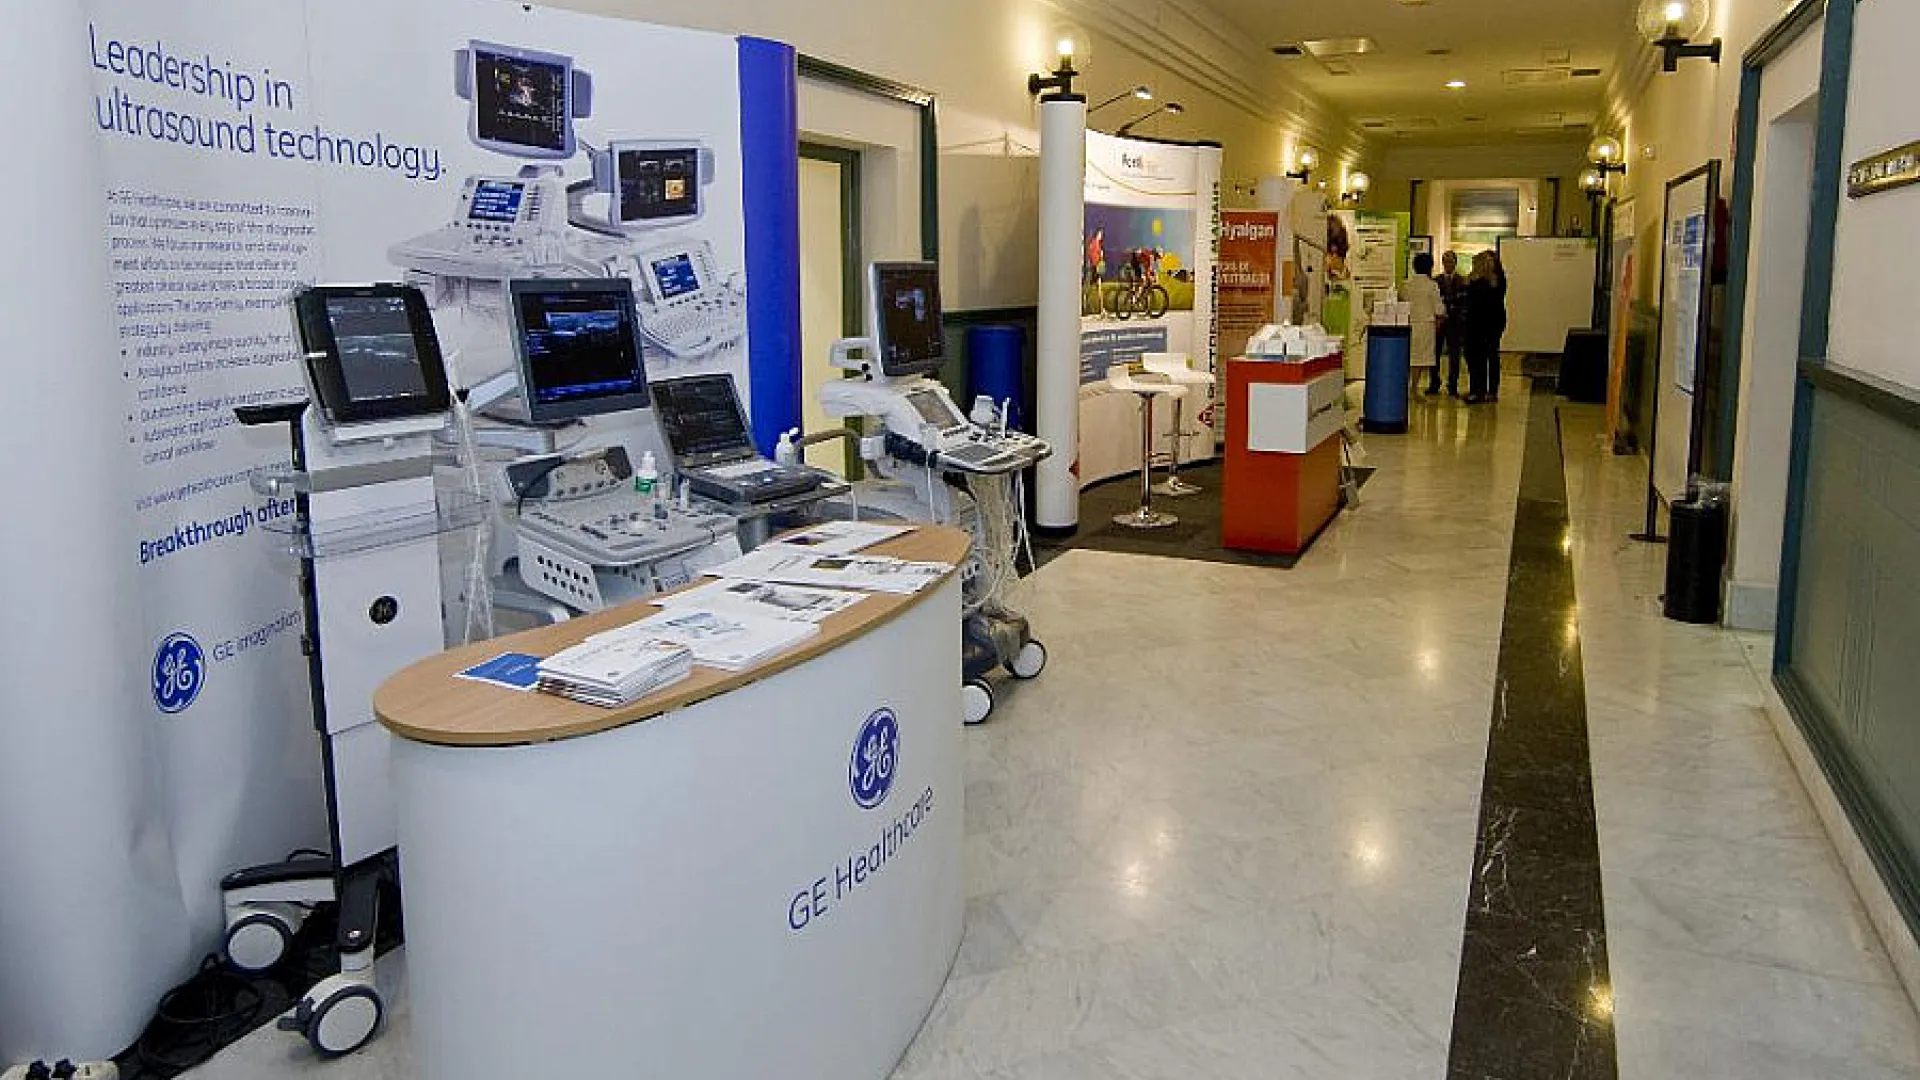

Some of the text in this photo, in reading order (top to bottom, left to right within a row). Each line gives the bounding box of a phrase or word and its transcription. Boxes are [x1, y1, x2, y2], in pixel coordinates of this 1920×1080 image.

[89, 22, 293, 111] Leadership in
[95, 87, 447, 181] ultrasound technology.
[1219, 220, 1275, 242] Hyalgan
[139, 506, 255, 565] Breakthrough
[213, 641, 235, 661] GE
[788, 786, 933, 930] GE Healthcare
